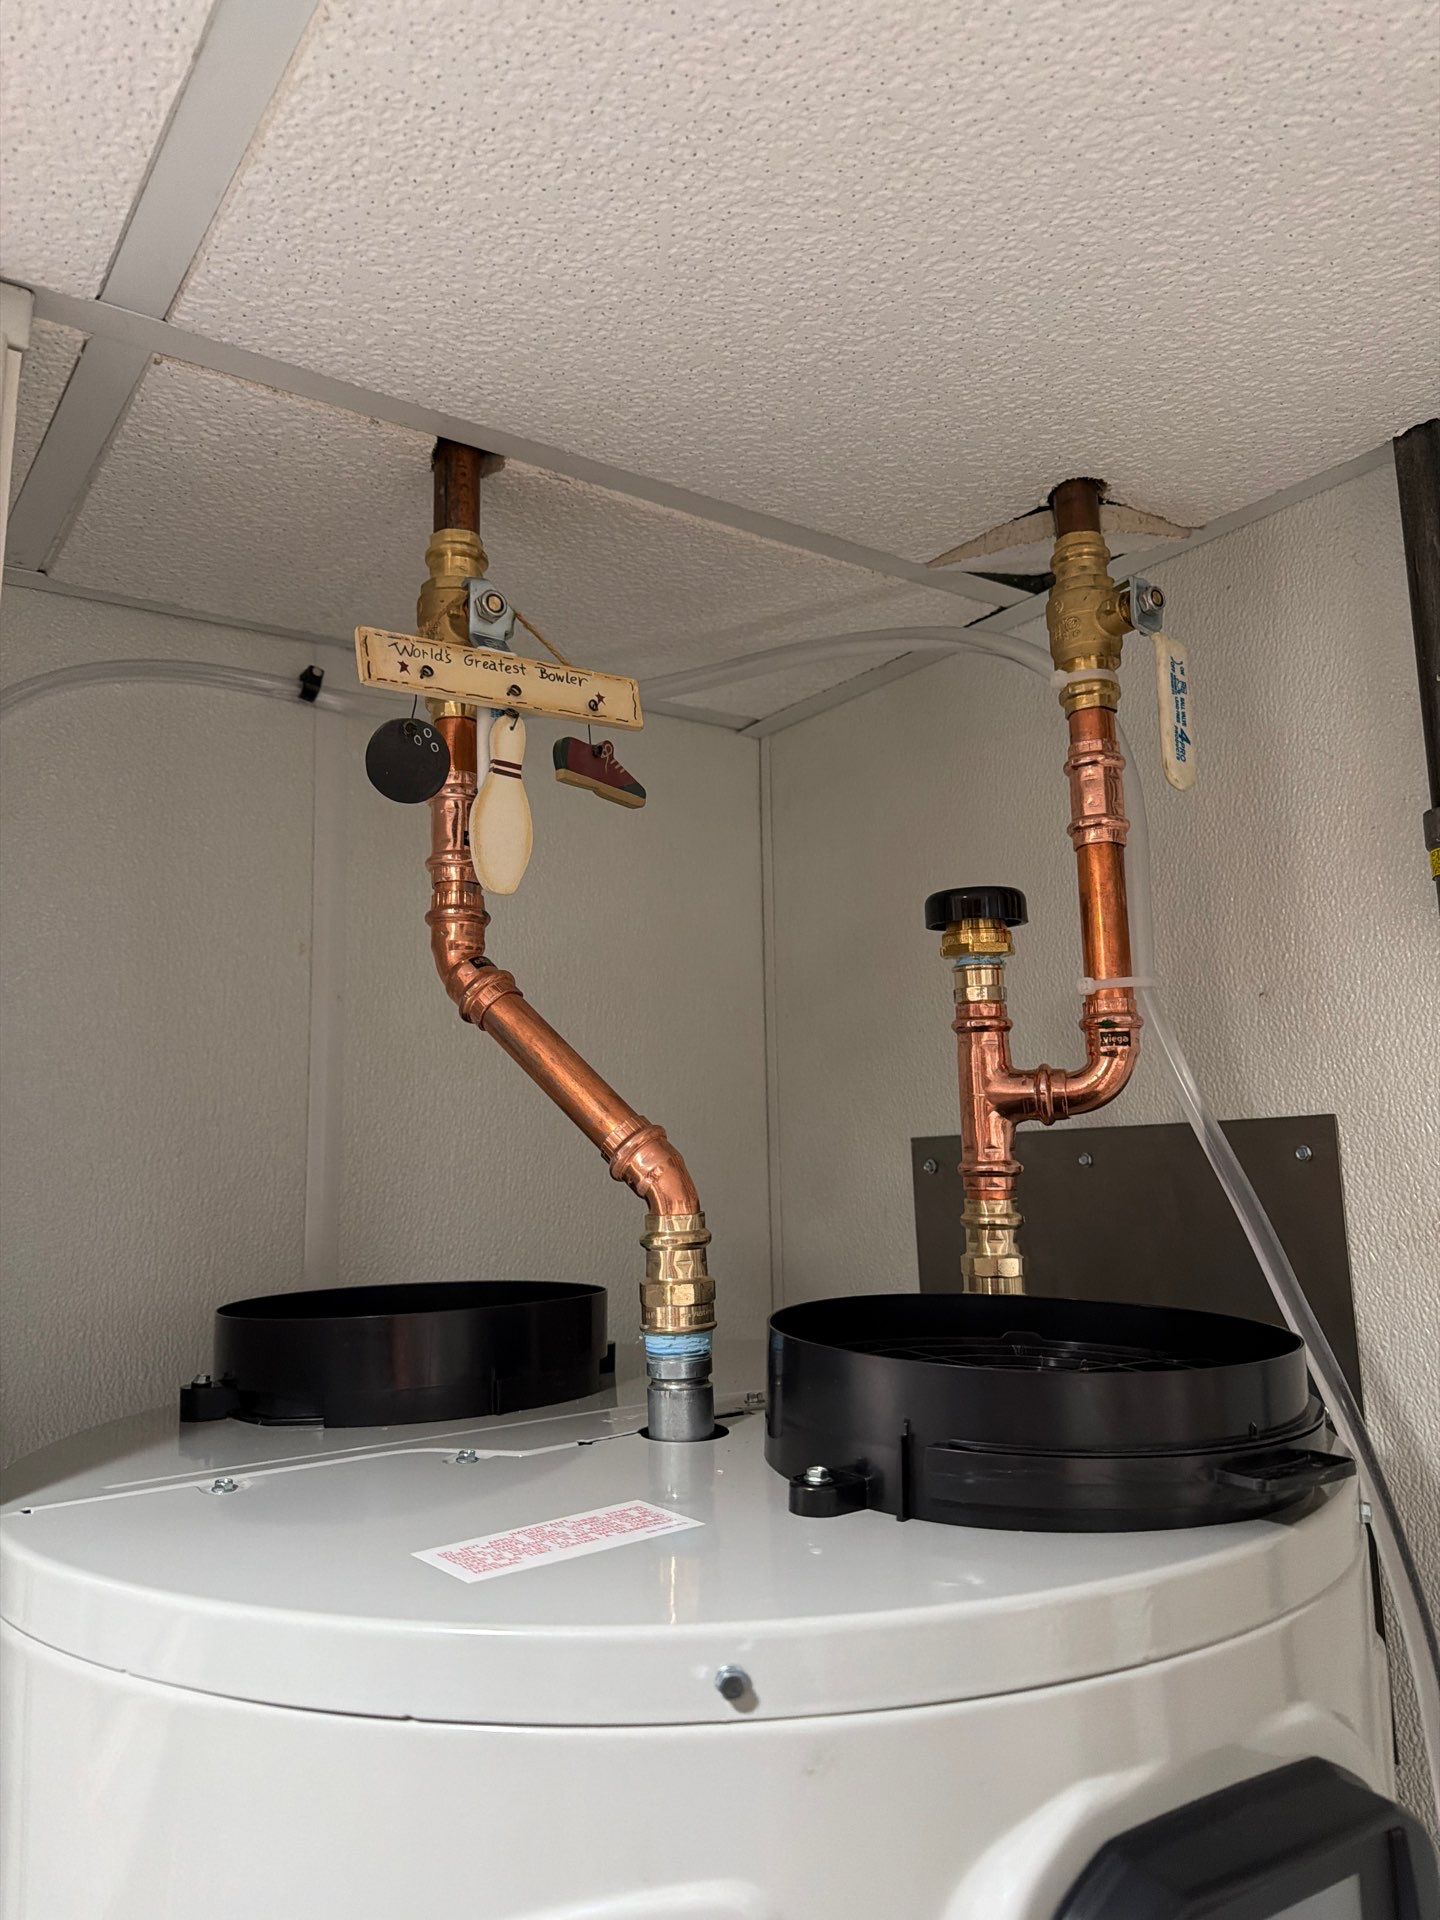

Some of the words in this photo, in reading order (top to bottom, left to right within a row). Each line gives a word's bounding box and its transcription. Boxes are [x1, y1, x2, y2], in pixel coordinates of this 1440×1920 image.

[388, 641, 452, 664] World's
[464, 655, 527, 676] Greatest
[539, 666, 589, 687] Bowler
[1103, 1034, 1129, 1044] viega
